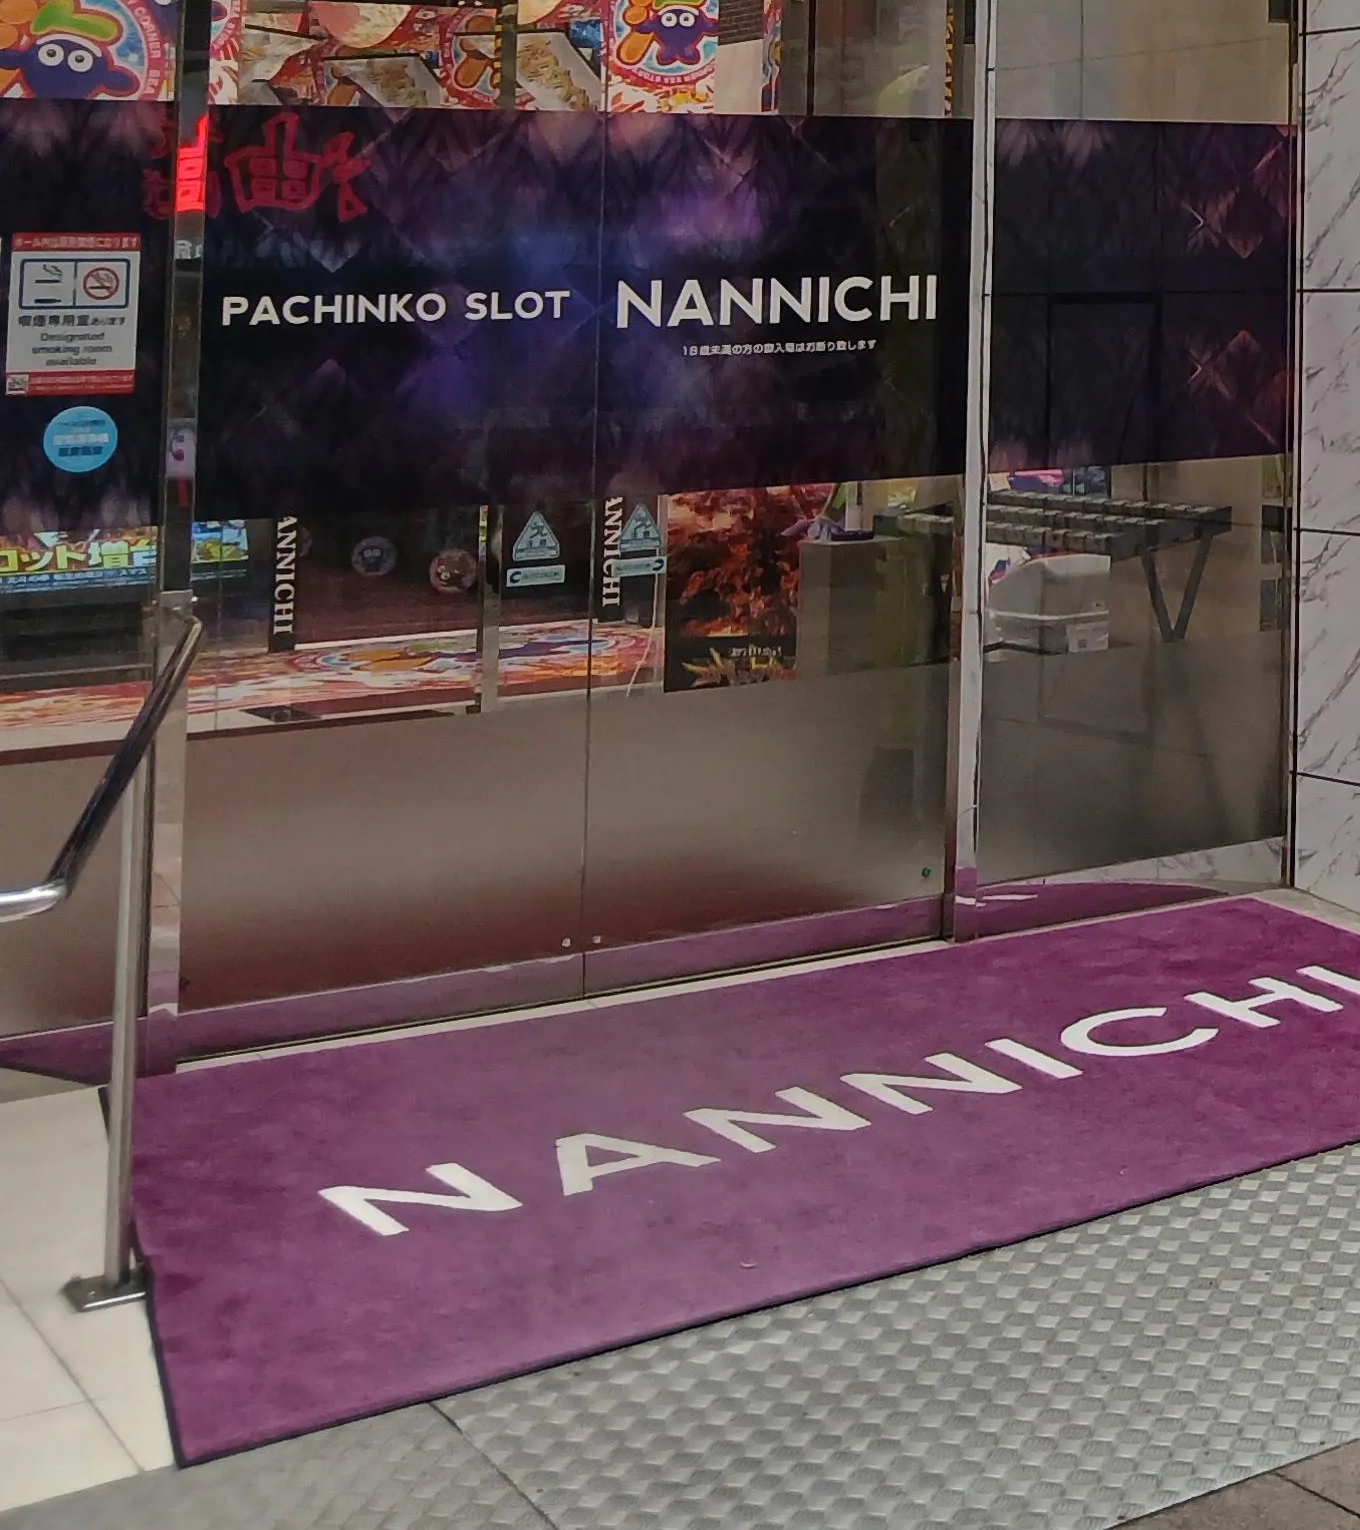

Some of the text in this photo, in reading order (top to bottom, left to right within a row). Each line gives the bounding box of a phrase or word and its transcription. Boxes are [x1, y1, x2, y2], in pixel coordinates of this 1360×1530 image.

[221, 274, 938, 329] PACHINKO SLOT NANNICHI
[0, 539, 158, 574] ロット増台
[273, 516, 298, 635] ANNICHI
[602, 496, 624, 607] ANNICHI
